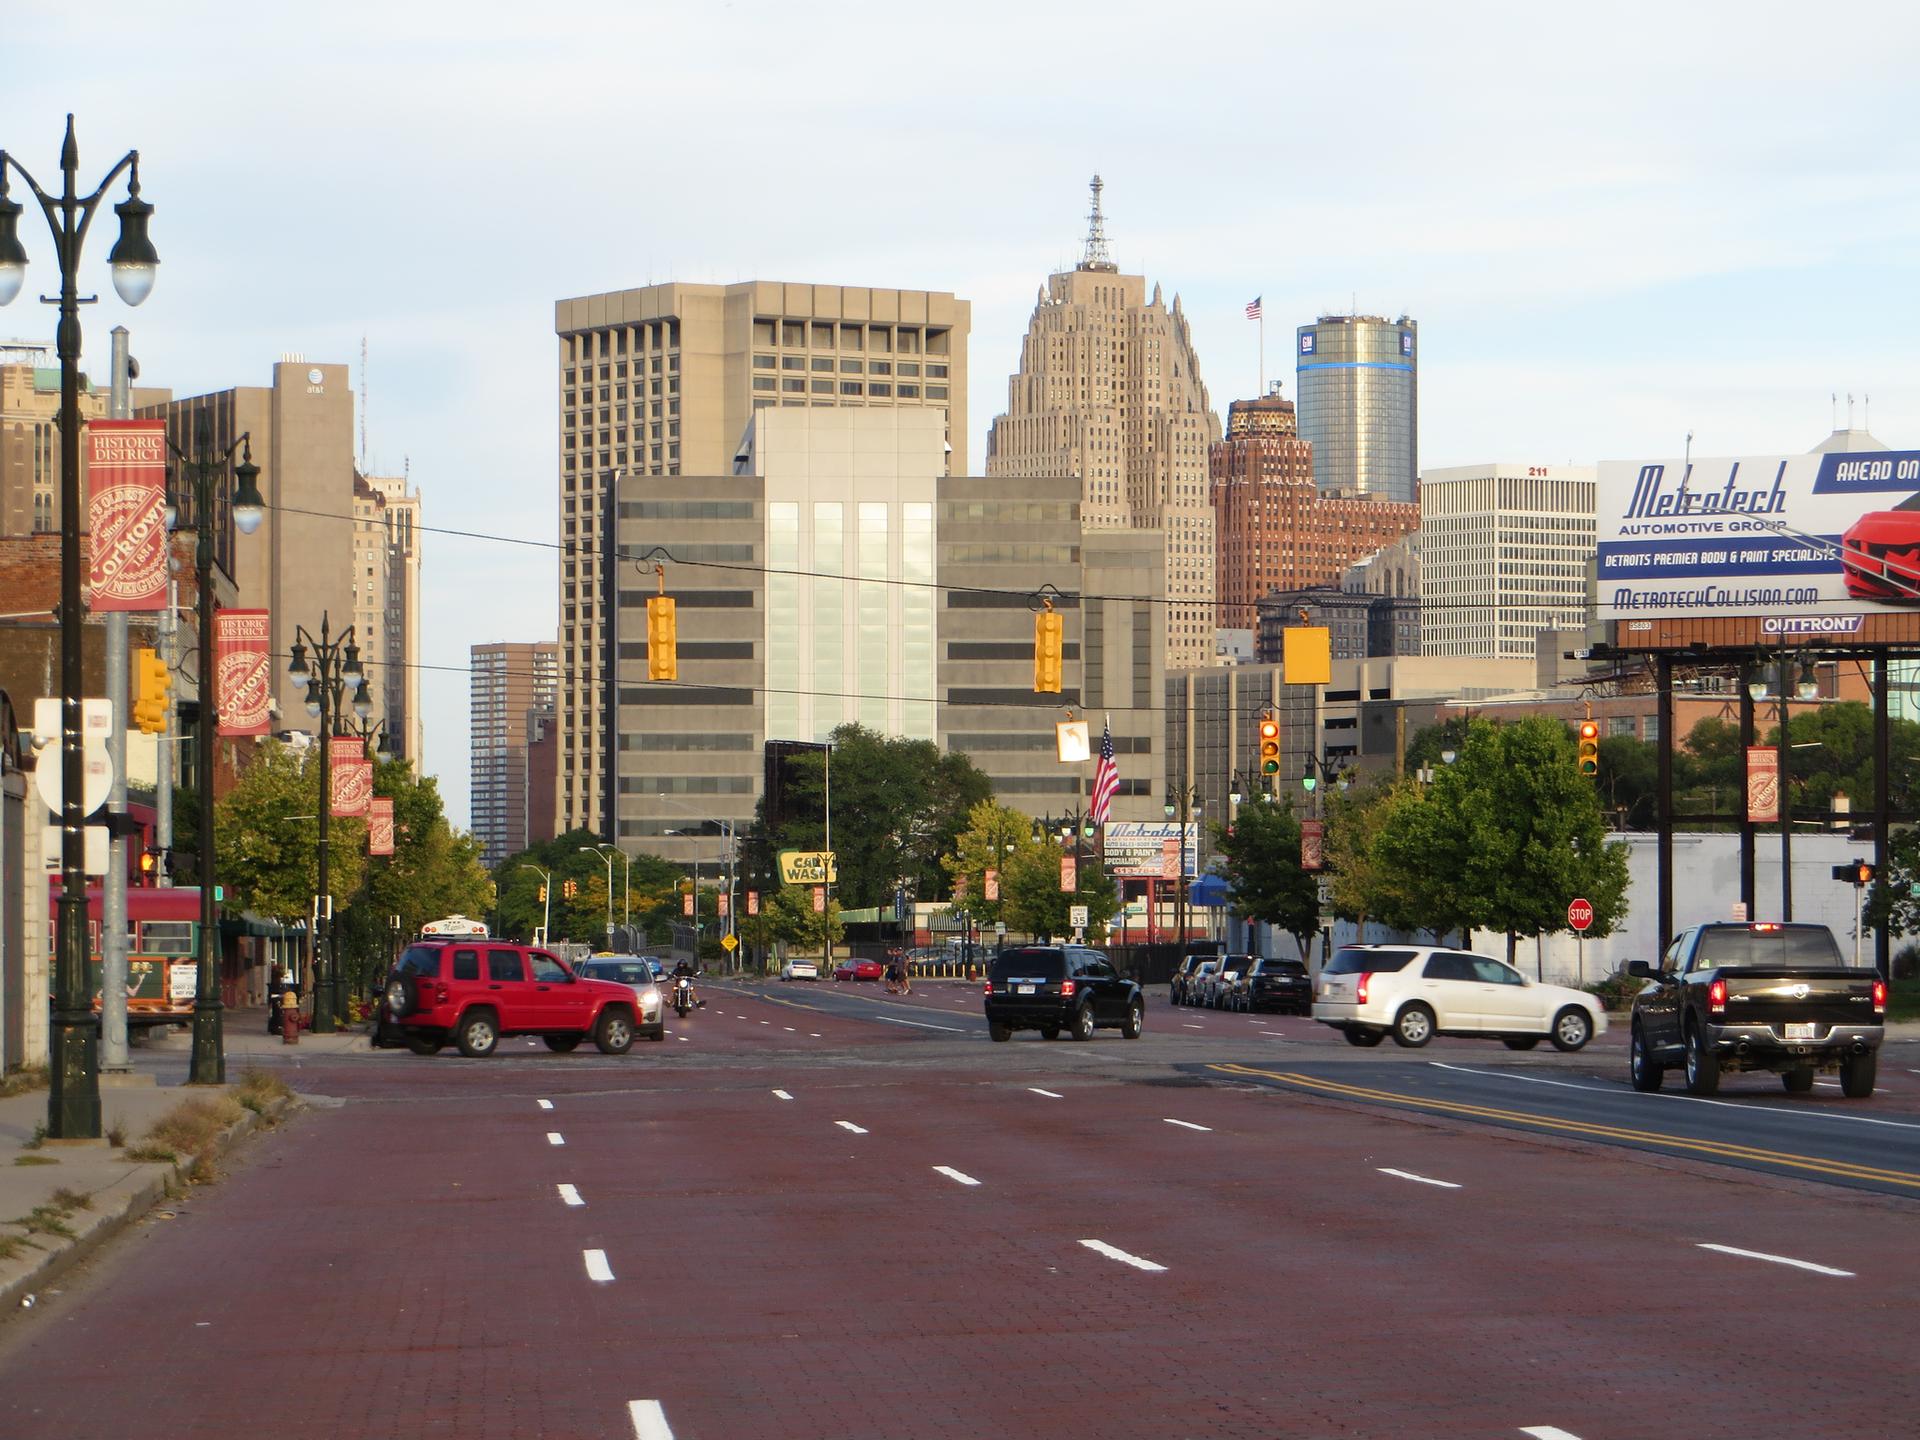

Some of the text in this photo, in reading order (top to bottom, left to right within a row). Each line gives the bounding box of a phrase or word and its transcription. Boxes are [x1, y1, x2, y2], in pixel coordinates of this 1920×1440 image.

[1302, 335, 1312, 347] GM
[306, 385, 324, 394] at&t
[94, 436, 162, 449] HISTORIC
[95, 449, 161, 461] DISTRICT
[1528, 466, 1547, 477] 211
[1836, 460, 1892, 482] AHEAD
[1622, 460, 1788, 519] Metrotech
[105, 486, 148, 508] OLDEST
[101, 514, 126, 542] Since
[1618, 520, 1788, 535] AUTOMOTIVE GROUP
[90, 496, 167, 588] Corktown
[1605, 547, 1836, 567] DETROITS PREMIER BODY & PAINT SPECIALISTS
[220, 619, 266, 629] HISTORIC
[1765, 616, 1857, 633] OUTFRONT
[222, 628, 265, 636] DISTRICT
[219, 659, 270, 721] Corktown
[332, 769, 366, 807] Corktown
[1104, 848, 1123, 856] BODY
[1133, 848, 1156, 856] PAINT
[1104, 857, 1142, 865] SPECIALISTS
[1072, 916, 1086, 925] 35
[1570, 908, 1591, 920] STOP
